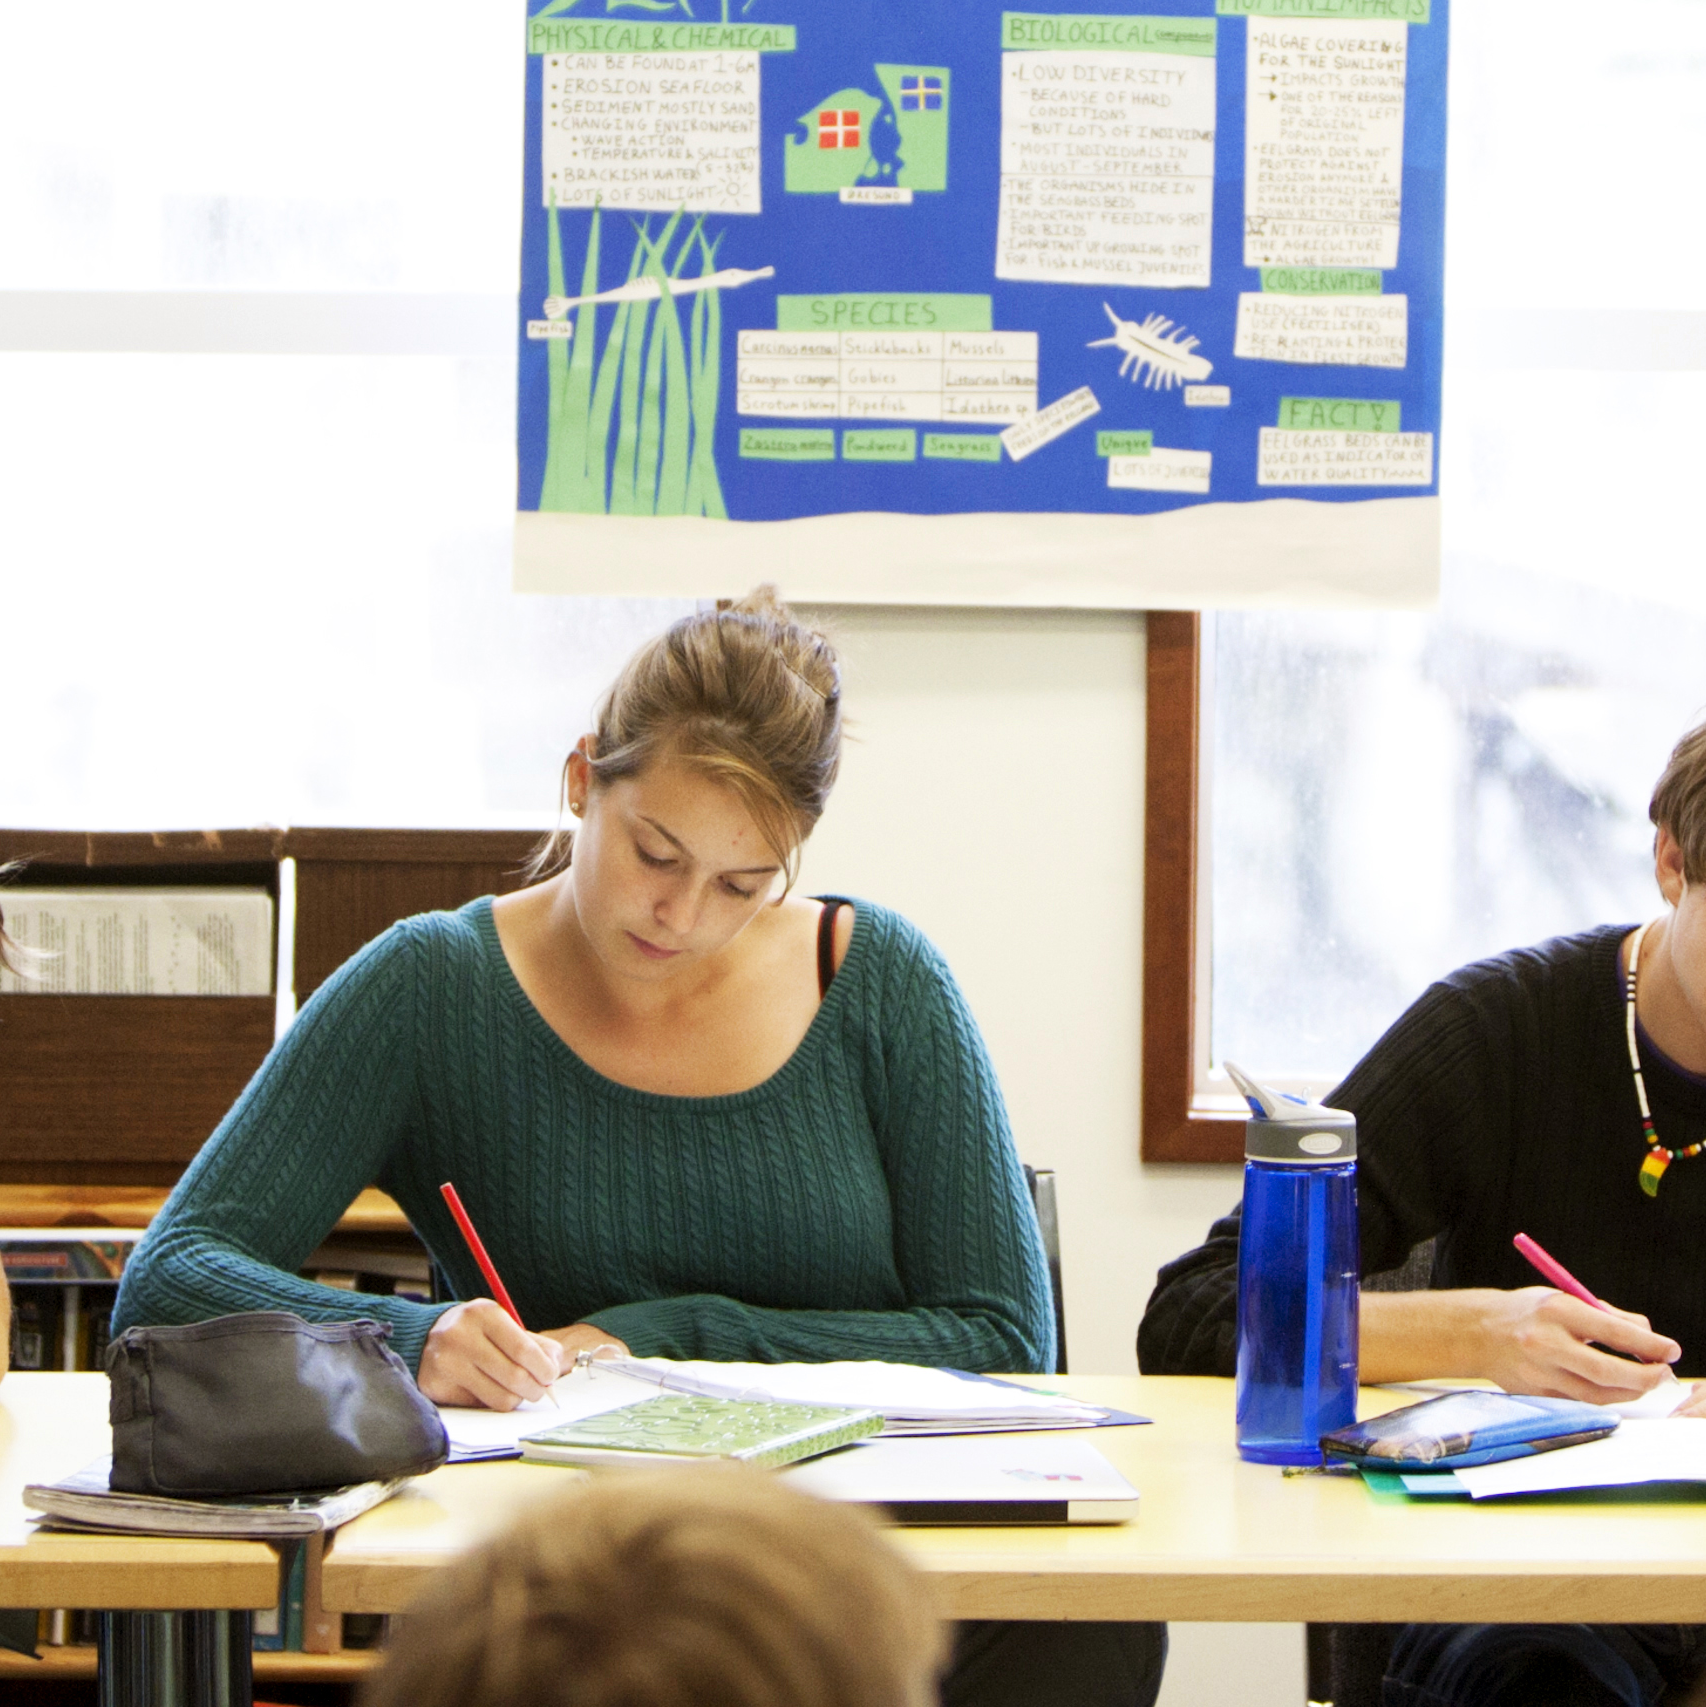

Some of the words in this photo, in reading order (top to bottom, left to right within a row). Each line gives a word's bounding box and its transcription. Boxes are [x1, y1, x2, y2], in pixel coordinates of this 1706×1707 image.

[531, 23, 652, 53] PHYSICAL
[671, 25, 788, 49] CHEMICAL
[1009, 18, 1154, 45] BIOLOGICAL
[1019, 63, 1065, 83] LOW
[1073, 65, 1186, 84] DIVERSITY
[1265, 268, 1381, 292] CONSERVATION
[811, 300, 937, 326] SPECIES
